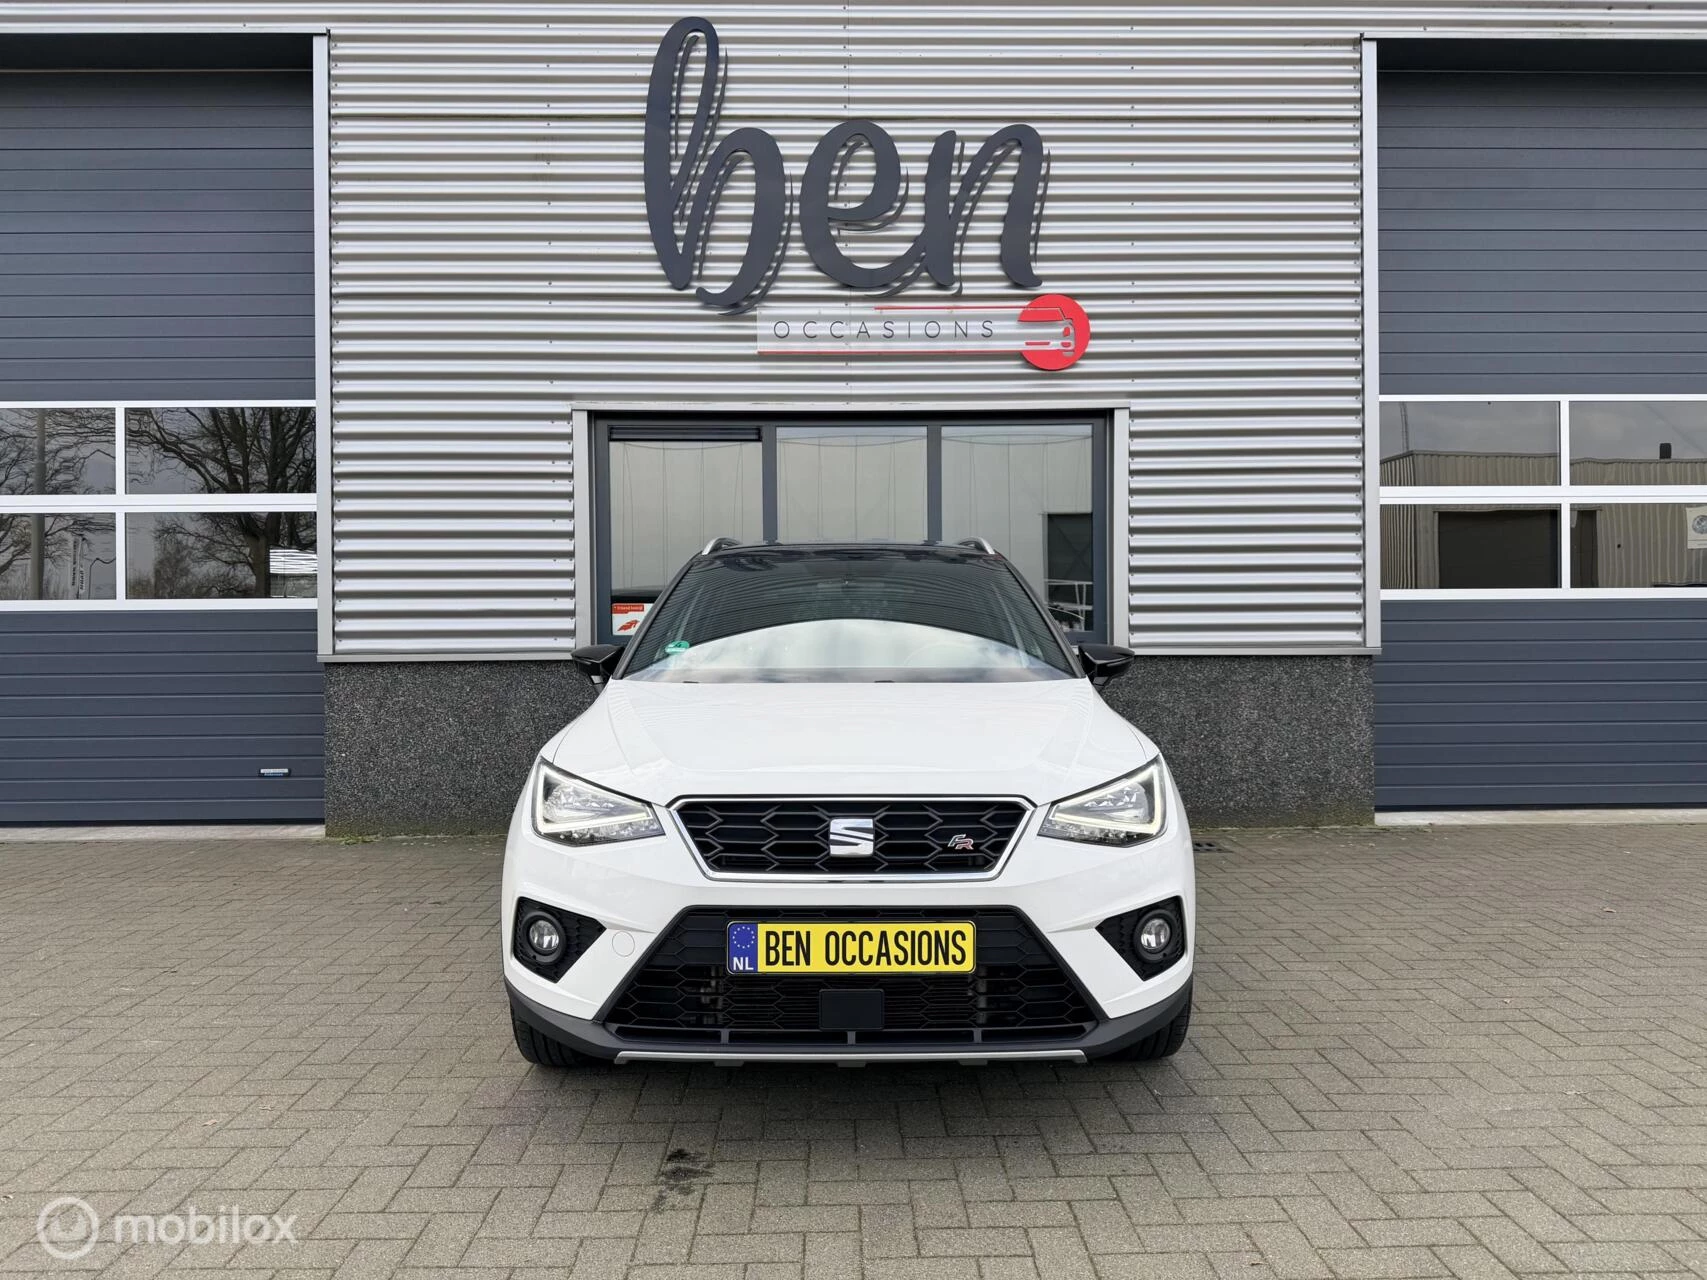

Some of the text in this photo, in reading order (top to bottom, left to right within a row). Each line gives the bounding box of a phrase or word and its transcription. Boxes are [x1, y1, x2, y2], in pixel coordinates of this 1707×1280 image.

[644, 16, 1043, 306] ben
[773, 320, 993, 339] OCCASIONS
[947, 833, 974, 850] FR
[765, 930, 967, 967] BEN OCCASIONS
[732, 957, 754, 971] NL
